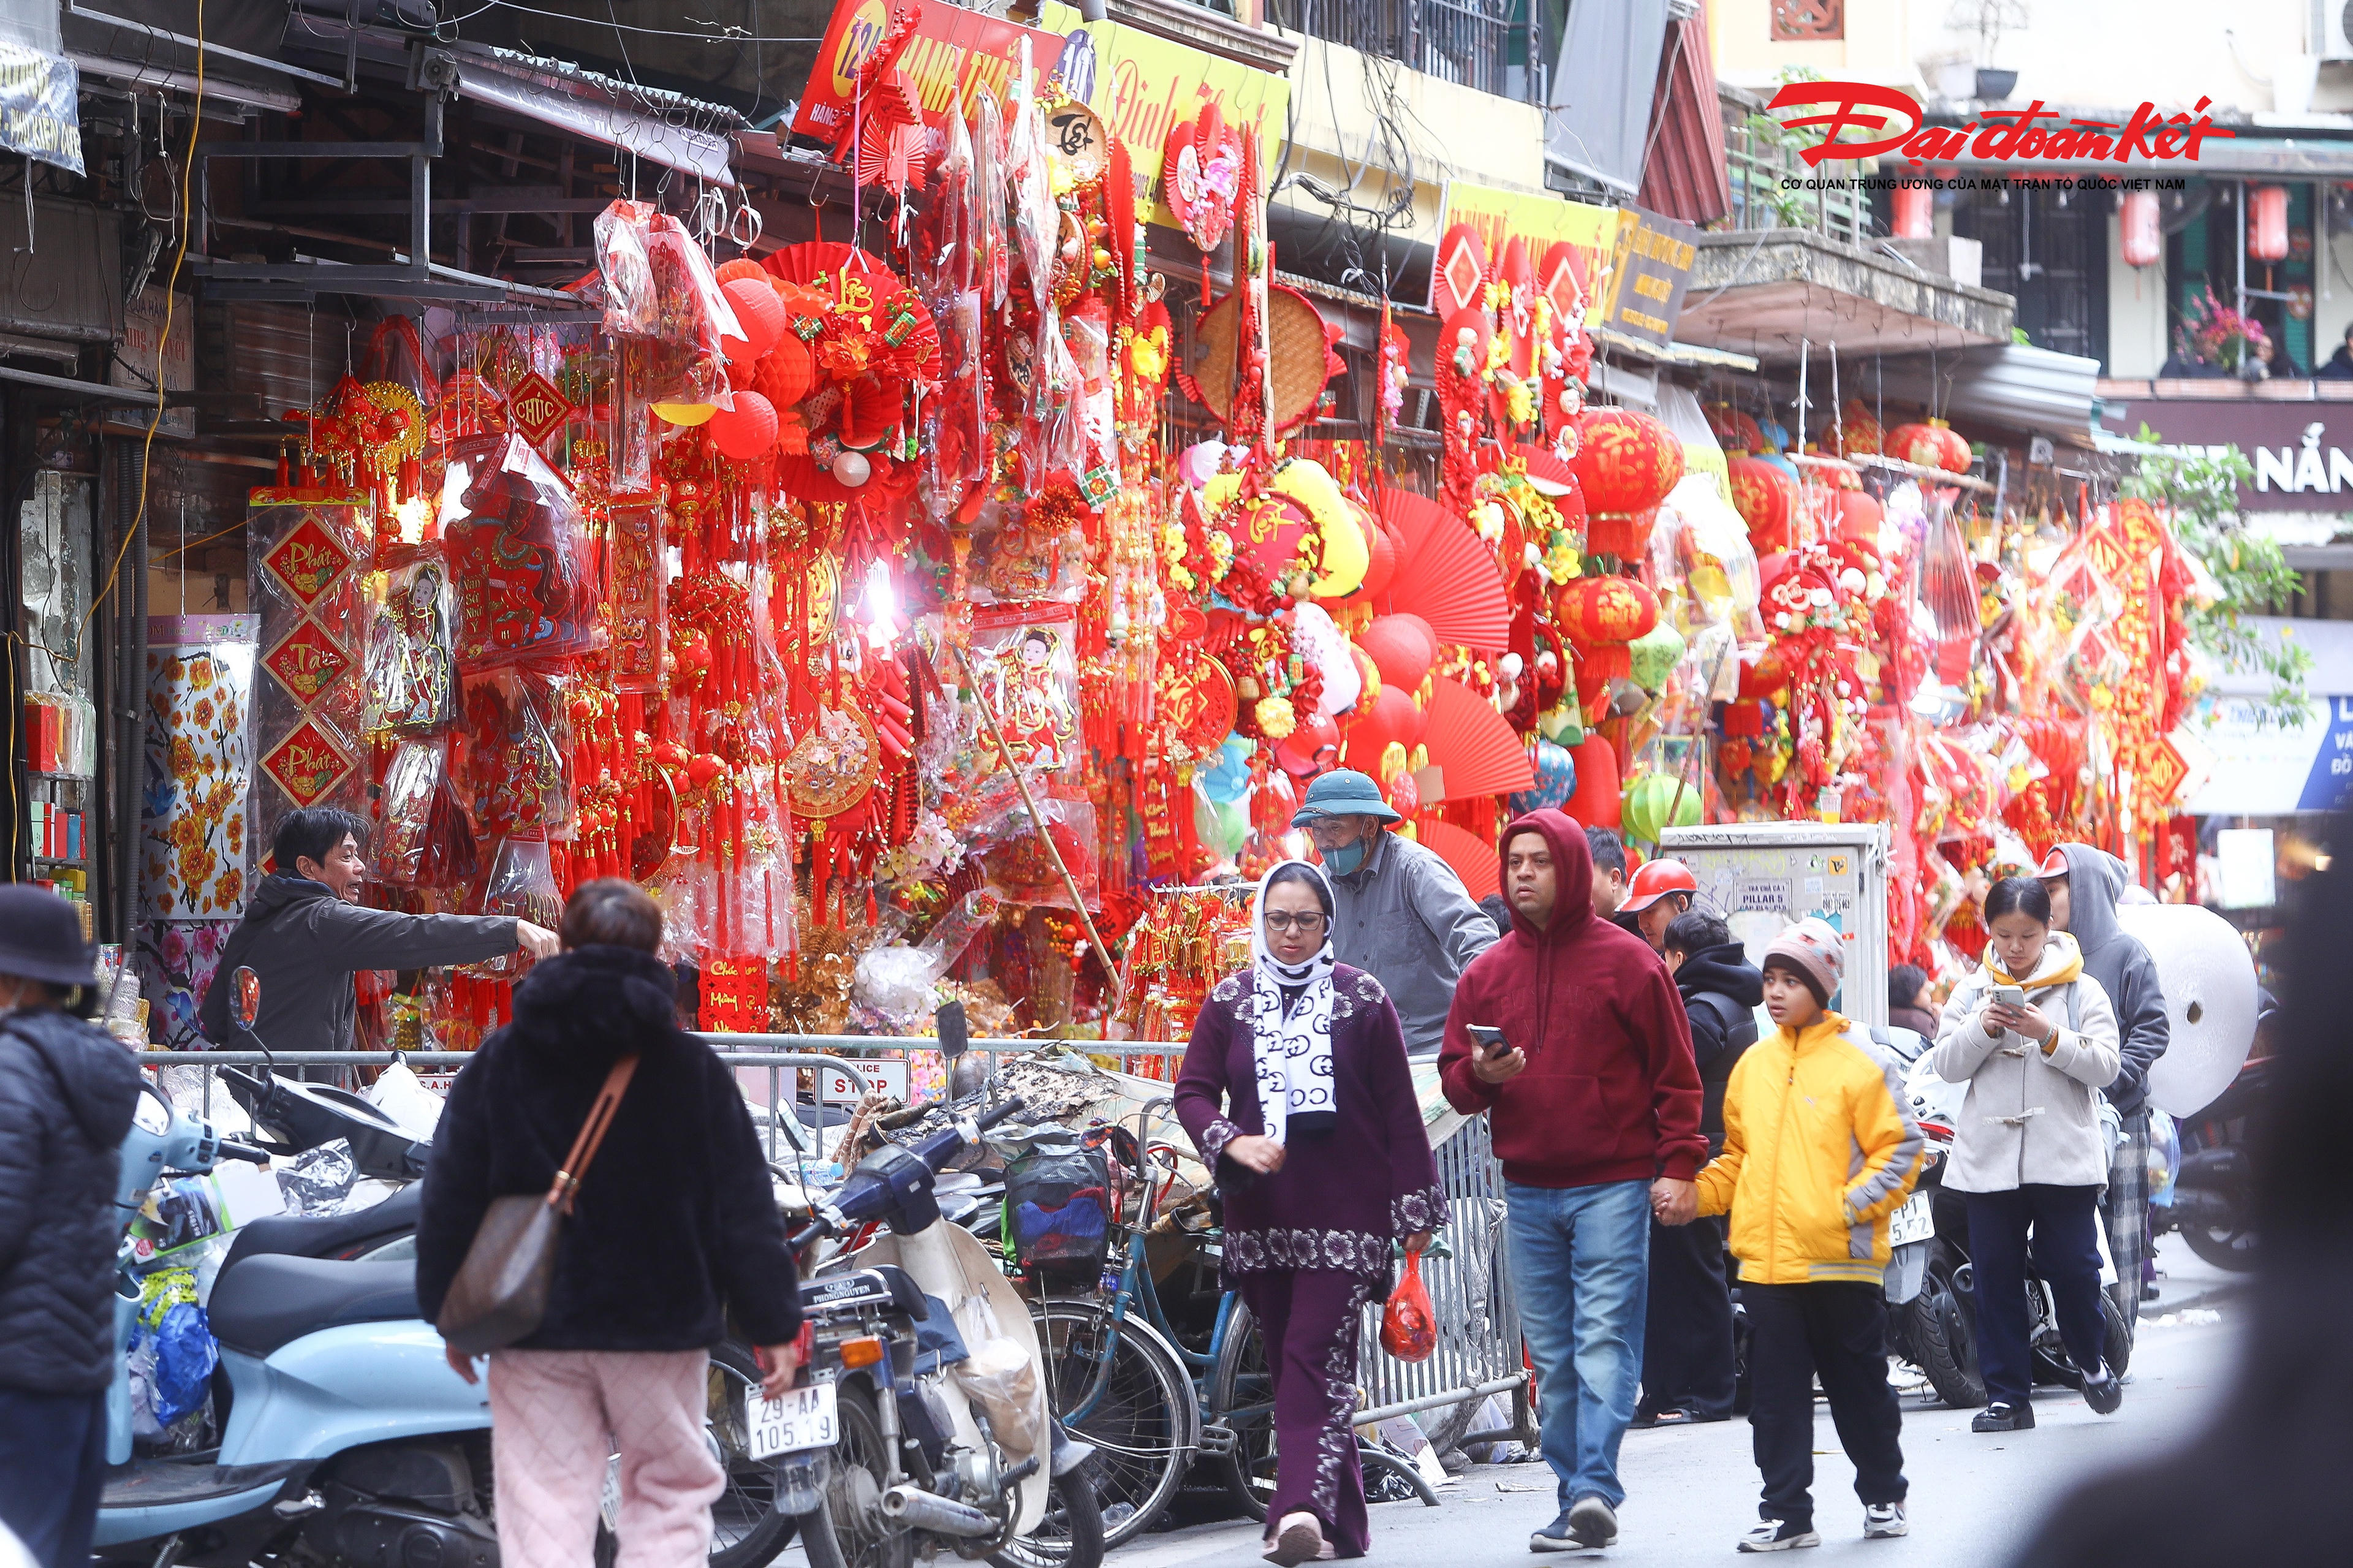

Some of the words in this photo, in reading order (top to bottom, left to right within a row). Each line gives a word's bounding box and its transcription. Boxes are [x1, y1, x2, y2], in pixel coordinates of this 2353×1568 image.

[515, 391, 554, 427] CHÚC
[289, 540, 332, 567] Phát
[287, 743, 331, 775] Phát
[1743, 895, 1775, 904] PILLAR
[710, 960, 738, 976] Chúc
[760, 1388, 819, 1423] 29-AA
[756, 1415, 831, 1453] 105.19
